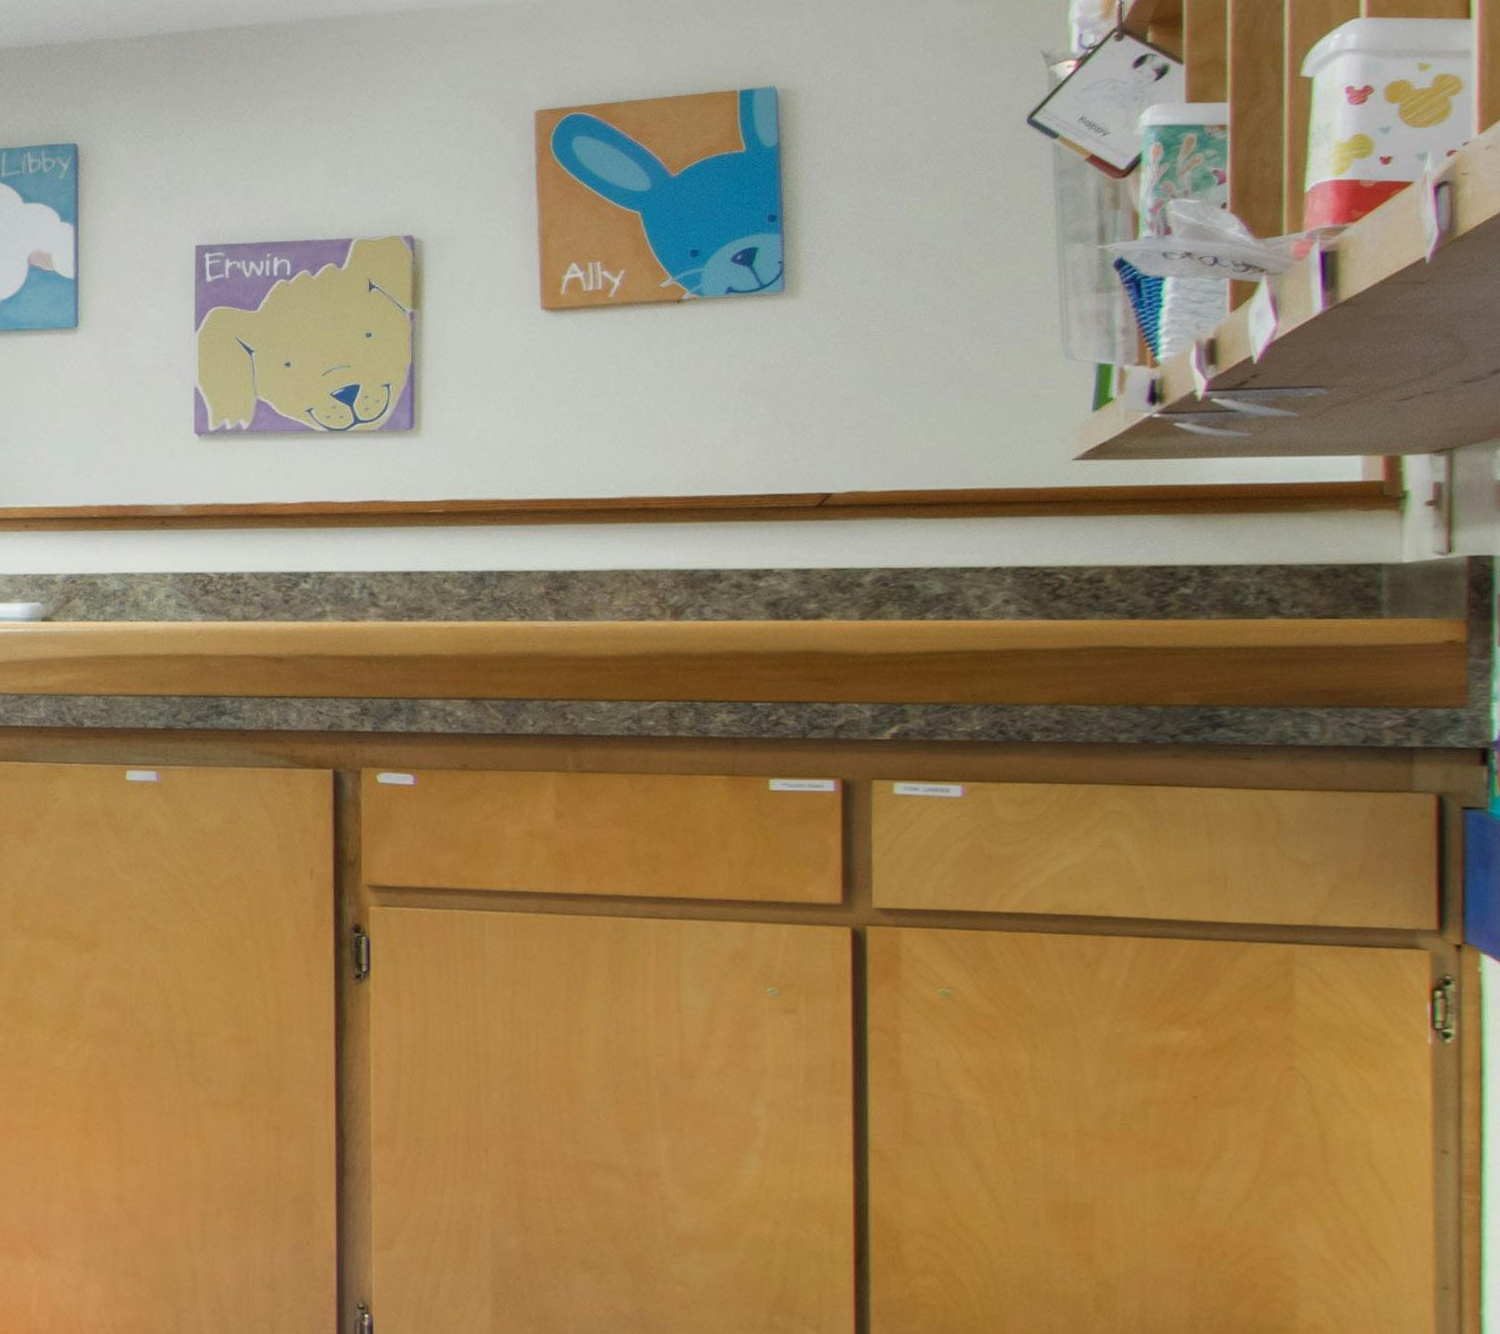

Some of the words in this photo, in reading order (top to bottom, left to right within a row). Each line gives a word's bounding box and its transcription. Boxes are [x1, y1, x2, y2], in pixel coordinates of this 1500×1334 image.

[1, 150, 73, 179] Libby
[204, 252, 292, 282] Erwin
[560, 261, 626, 298] Ally
